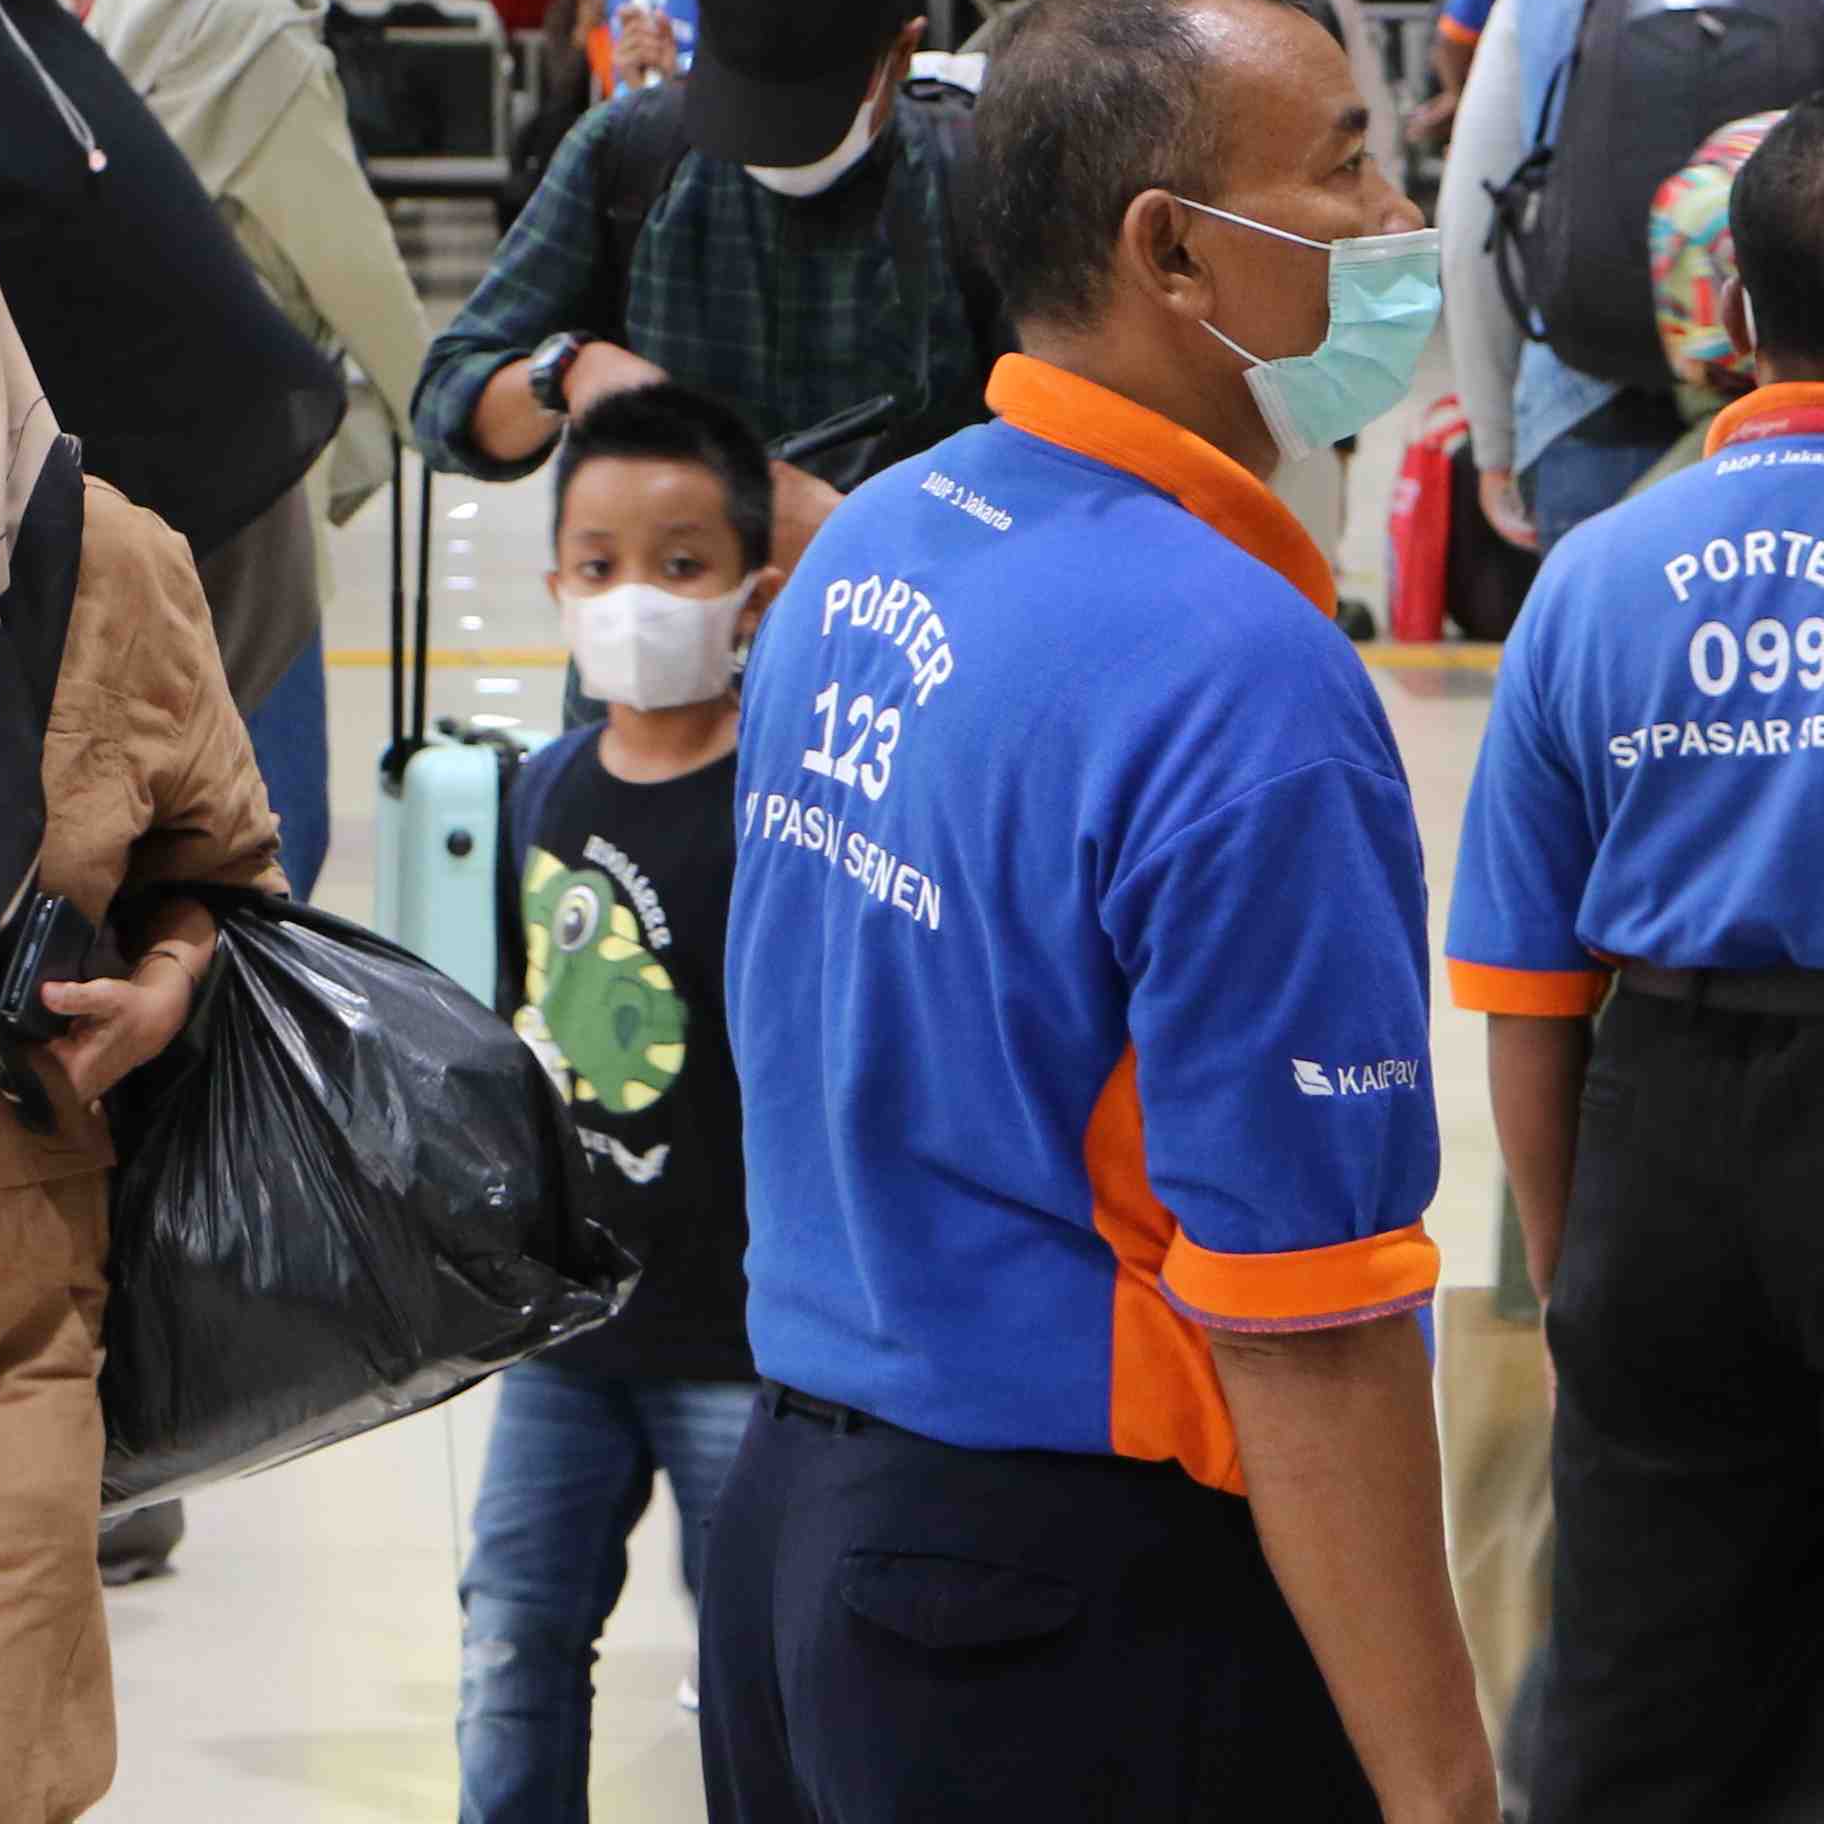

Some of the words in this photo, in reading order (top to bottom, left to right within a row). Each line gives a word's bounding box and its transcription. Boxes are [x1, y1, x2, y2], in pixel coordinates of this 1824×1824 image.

[960, 490, 1013, 531] Jakarta
[821, 574, 954, 708] PORTER
[801, 681, 902, 801] 123
[1650, 718, 1793, 759] PASAR
[843, 831, 941, 931] SENEN
[1337, 1058, 1420, 1096] KAIPay
